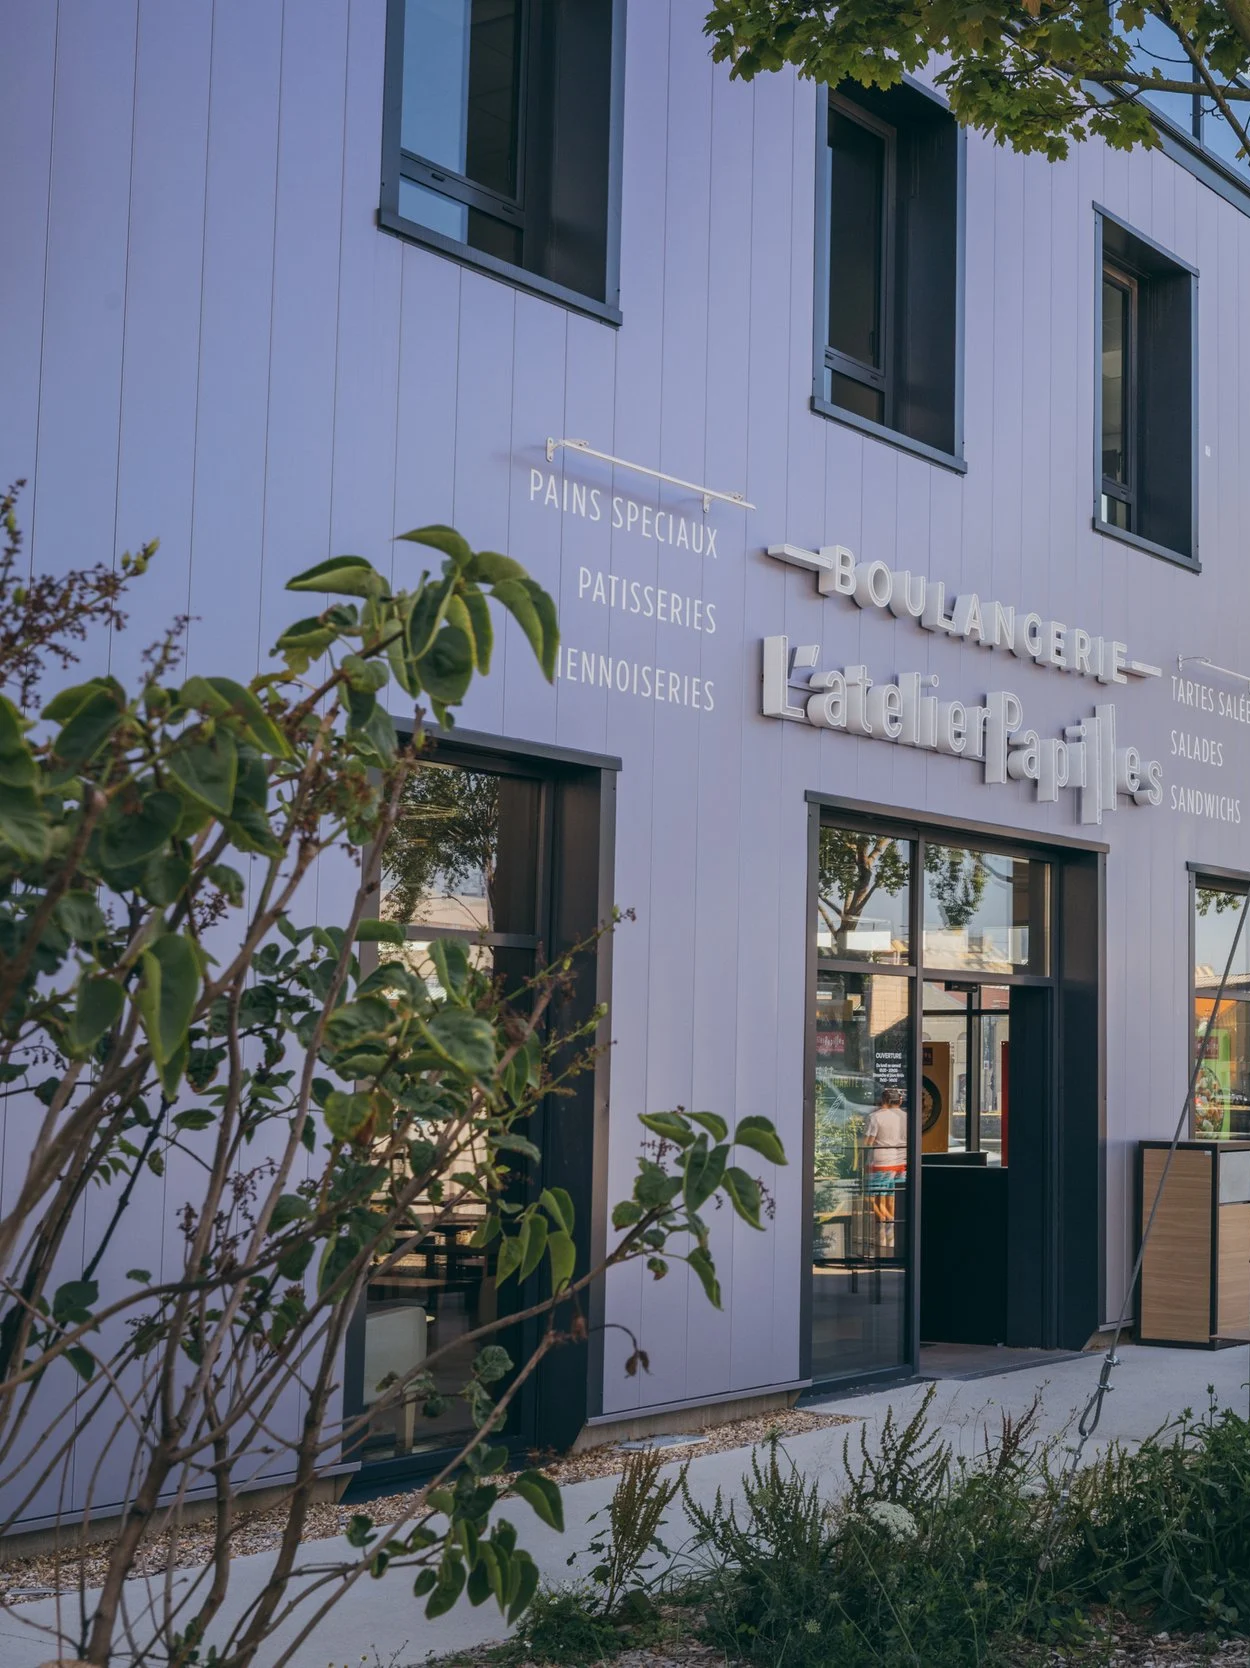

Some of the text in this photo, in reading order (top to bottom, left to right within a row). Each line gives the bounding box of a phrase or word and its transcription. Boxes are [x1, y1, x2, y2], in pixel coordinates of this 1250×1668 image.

[530, 468, 718, 559] PAINS SPECIAUX
[578, 566, 717, 635] PATISSERIES
[819, 544, 1128, 685] BOULANGERIE
[556, 645, 715, 712] IENNOISERIES
[1171, 675, 1214, 713] TARTES
[1170, 729, 1224, 767] SALADES
[1170, 784, 1241, 824] SANDWICHS
